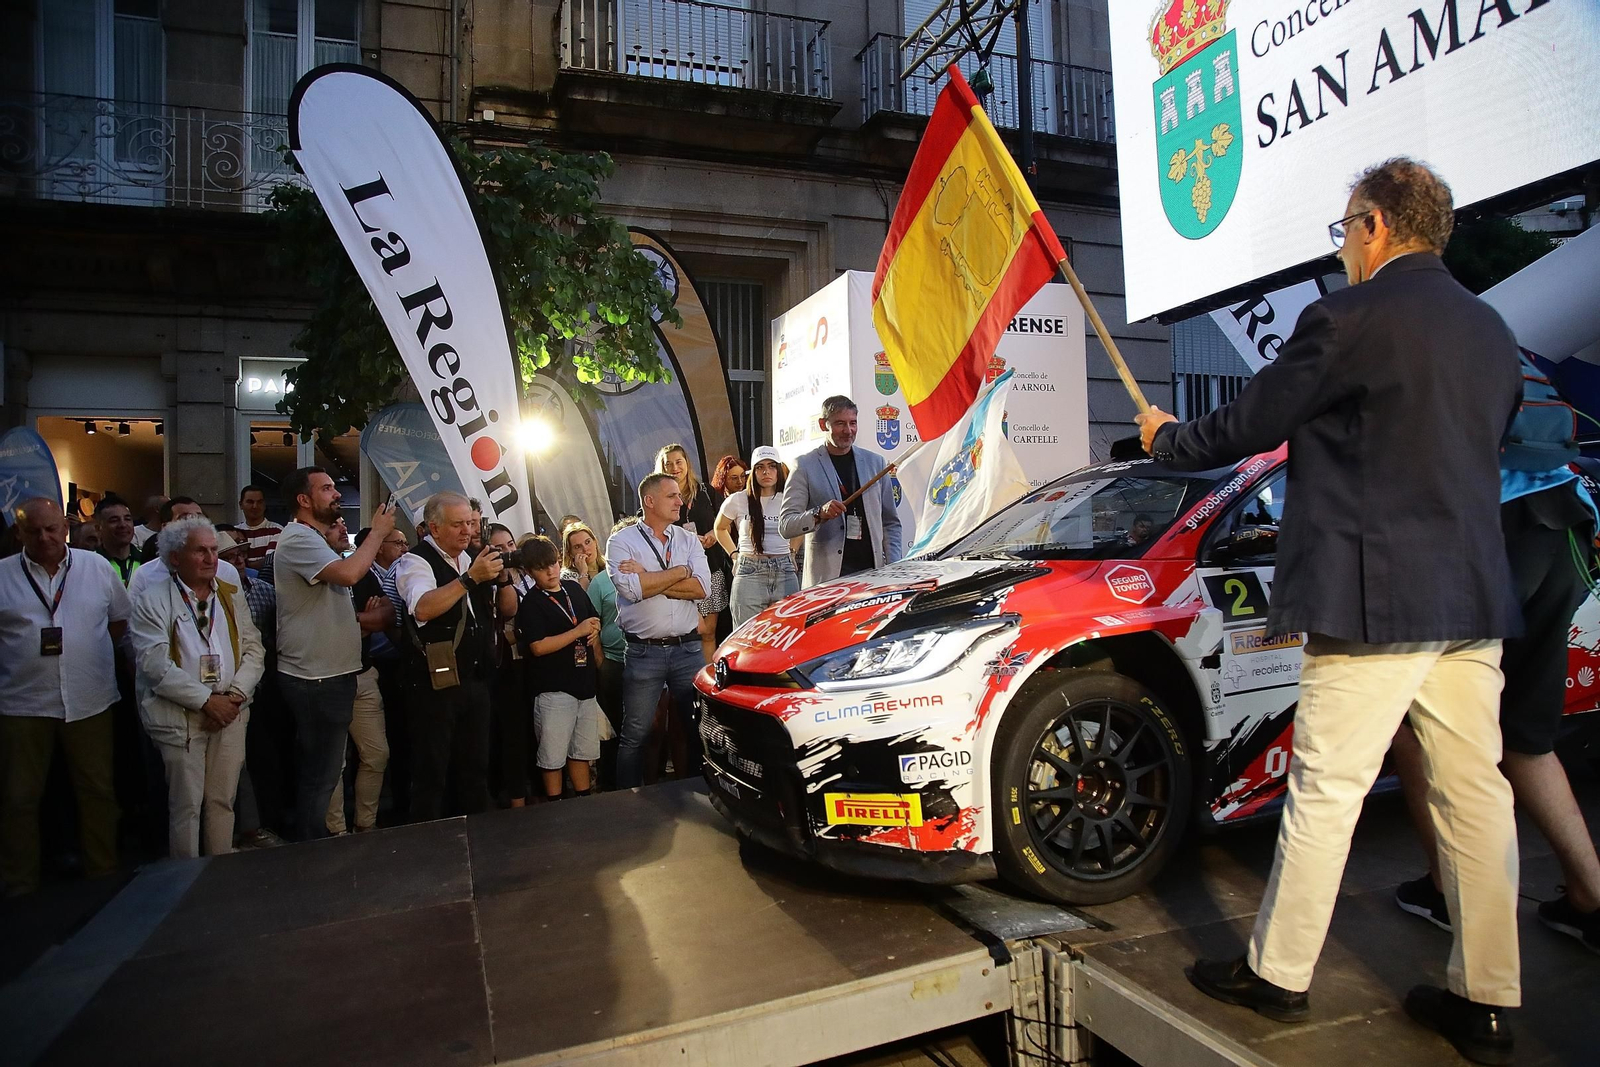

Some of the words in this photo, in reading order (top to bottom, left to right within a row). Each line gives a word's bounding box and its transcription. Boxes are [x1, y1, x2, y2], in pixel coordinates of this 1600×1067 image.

[1251, 0, 1350, 58] Conce
[1256, 49, 1350, 148] SAN
[1366, 0, 1551, 95] AMA
[1007, 317, 1064, 334] RENSE
[338, 170, 411, 278] La
[396, 275, 520, 521] Región
[1012, 371, 1040, 379] Concello
[1012, 383, 1019, 391] A
[1020, 383, 1056, 392] ARNOIA
[1012, 423, 1041, 432] Concello
[1041, 424, 1050, 432] de
[1013, 435, 1059, 444] CARTELLE
[1185, 456, 1267, 530] grupobreogan.com
[1111, 574, 1147, 586] SEGURO
[1115, 582, 1150, 593] TOYOTA
[1224, 578, 1256, 616] 2
[1250, 654, 1283, 664] HOSPITAL
[1251, 661, 1292, 677] recoletas
[815, 694, 944, 723] CLIMAREYMA
[918, 750, 972, 771] PAGID
[902, 768, 975, 783] RACING
[834, 799, 911, 820] PIRELLI
